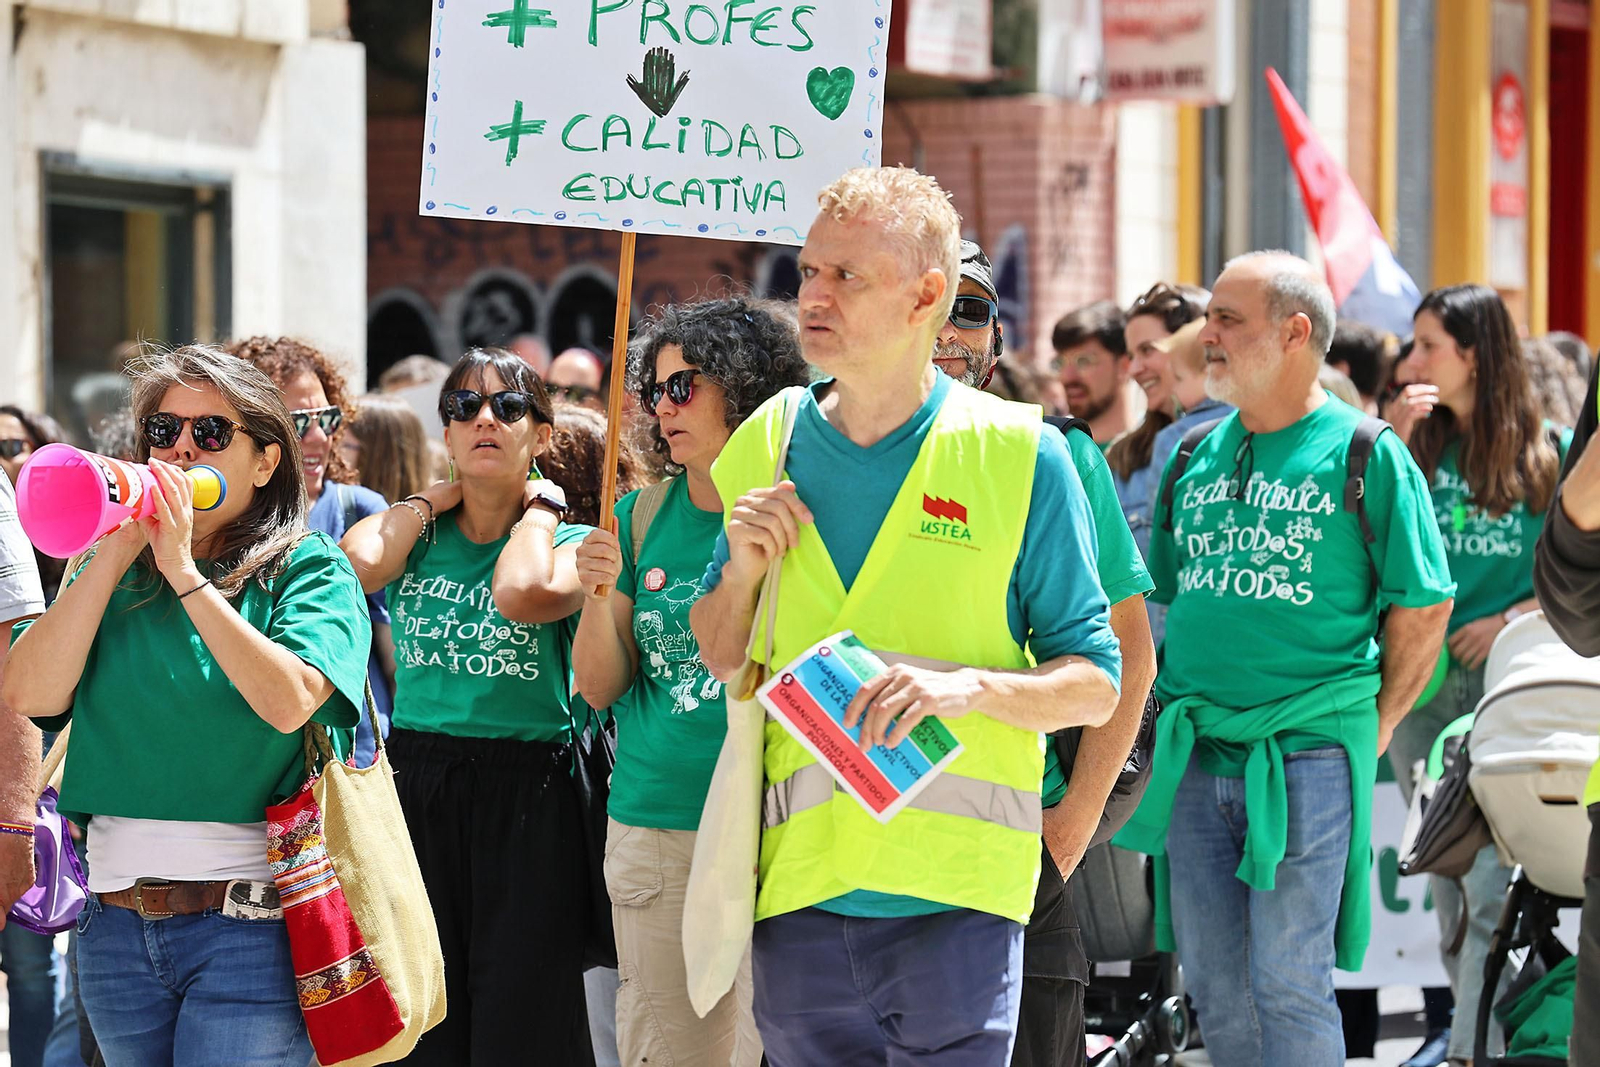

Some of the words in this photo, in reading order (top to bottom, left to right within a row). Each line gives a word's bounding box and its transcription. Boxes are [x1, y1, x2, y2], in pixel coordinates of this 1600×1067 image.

[589, 0, 815, 51] PROFES
[1183, 477, 1251, 509] ESCUEA
[921, 520, 971, 541] USTEA
[1187, 531, 1221, 558] DE
[399, 576, 475, 606] ESCUELA
[405, 616, 433, 637] DE
[441, 619, 529, 645] TOD@S
[447, 652, 539, 680] TOD@S
[820, 677, 833, 692] DE
[830, 691, 842, 705] LA
[779, 687, 845, 757] ORGANIZACIONES
[849, 763, 887, 804] PARTIDOS
[807, 730, 848, 772] POLÍTICOS
[919, 720, 951, 757] ECTIVOS
[890, 745, 923, 780] ECTIVOS
